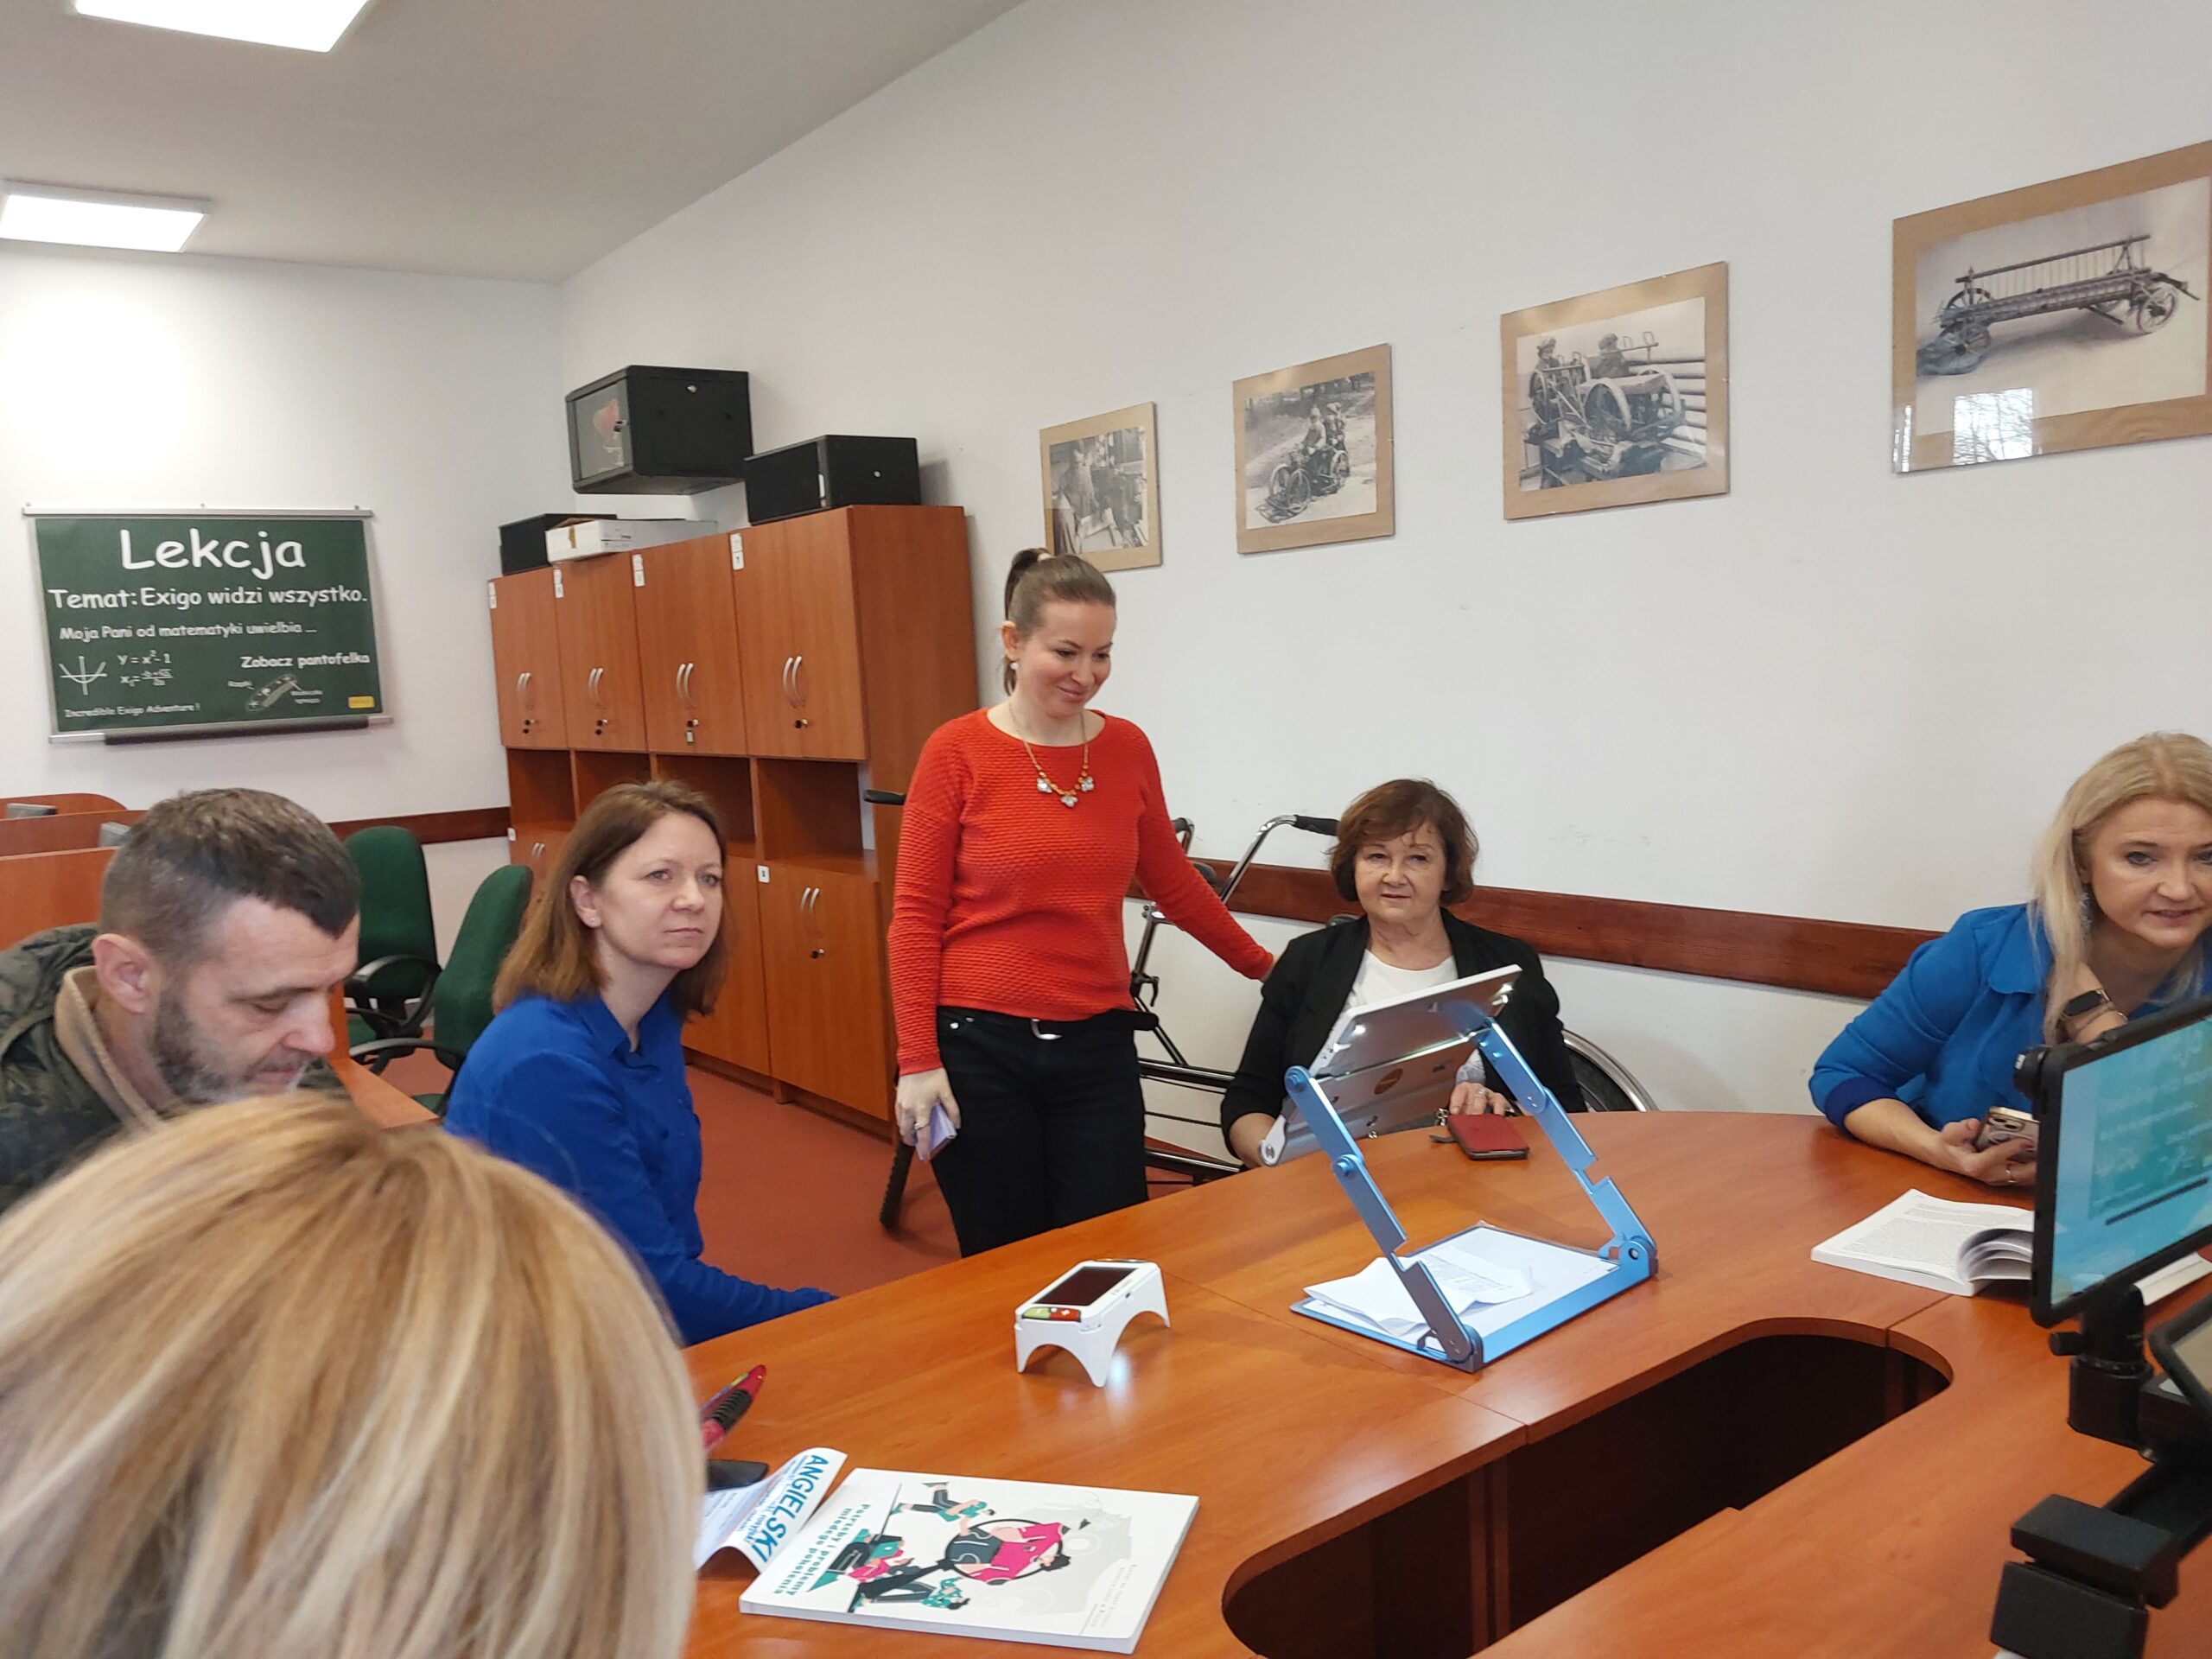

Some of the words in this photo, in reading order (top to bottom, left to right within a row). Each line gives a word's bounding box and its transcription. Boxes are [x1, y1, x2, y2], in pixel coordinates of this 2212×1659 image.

[119, 528, 307, 580] Lekcja
[48, 588, 138, 609] Temat:
[140, 588, 202, 610] Exigo
[207, 587, 263, 604] widzi
[268, 585, 368, 607] wszystko.
[60, 626, 99, 642] Moja
[102, 626, 132, 639] Pani
[137, 624, 156, 637] od
[158, 622, 243, 639] matematyki
[246, 621, 302, 635] uwielbia
[240, 656, 293, 668] Zobacz
[297, 652, 371, 669] pantofelka
[750, 1454, 829, 1562] ANGIELSKI
[772, 1546, 818, 1596] pokolenia
[785, 1549, 833, 1597] problemy
